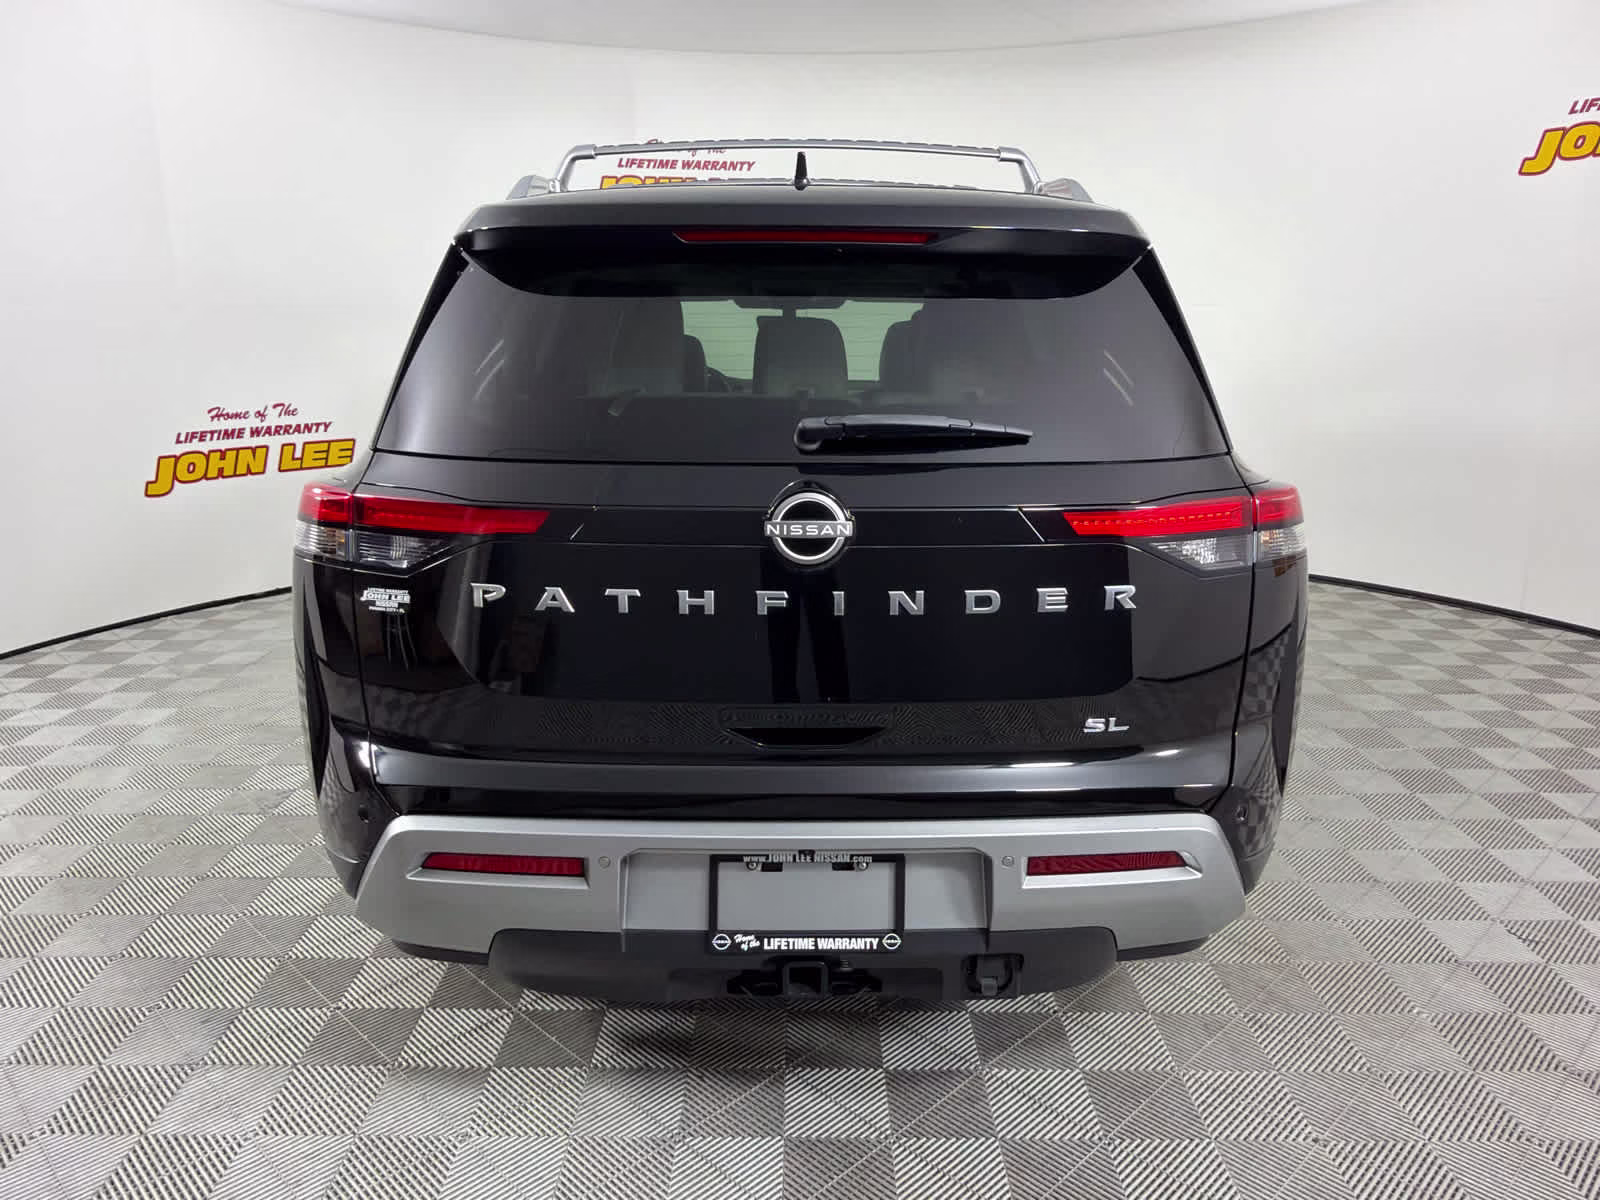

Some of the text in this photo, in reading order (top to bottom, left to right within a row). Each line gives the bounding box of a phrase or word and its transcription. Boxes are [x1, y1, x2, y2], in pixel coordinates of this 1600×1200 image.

[1567, 97, 1600, 115] LIF
[1518, 121, 1600, 176] JO
[617, 157, 755, 172] LIFETIME WARRANTY
[207, 402, 298, 422] Home of The
[175, 421, 333, 445] LIFETIME WARRANTY
[144, 438, 356, 498] JOHN LEE
[767, 524, 851, 536] NISSAN
[360, 590, 411, 603] JOHN LEE
[470, 582, 1138, 616] PATHFINDER
[1082, 717, 1130, 733] SL
[796, 853, 812, 863] LEE
[734, 934, 756, 943] Home
[763, 937, 879, 950] LIFETIME WARRANTY
